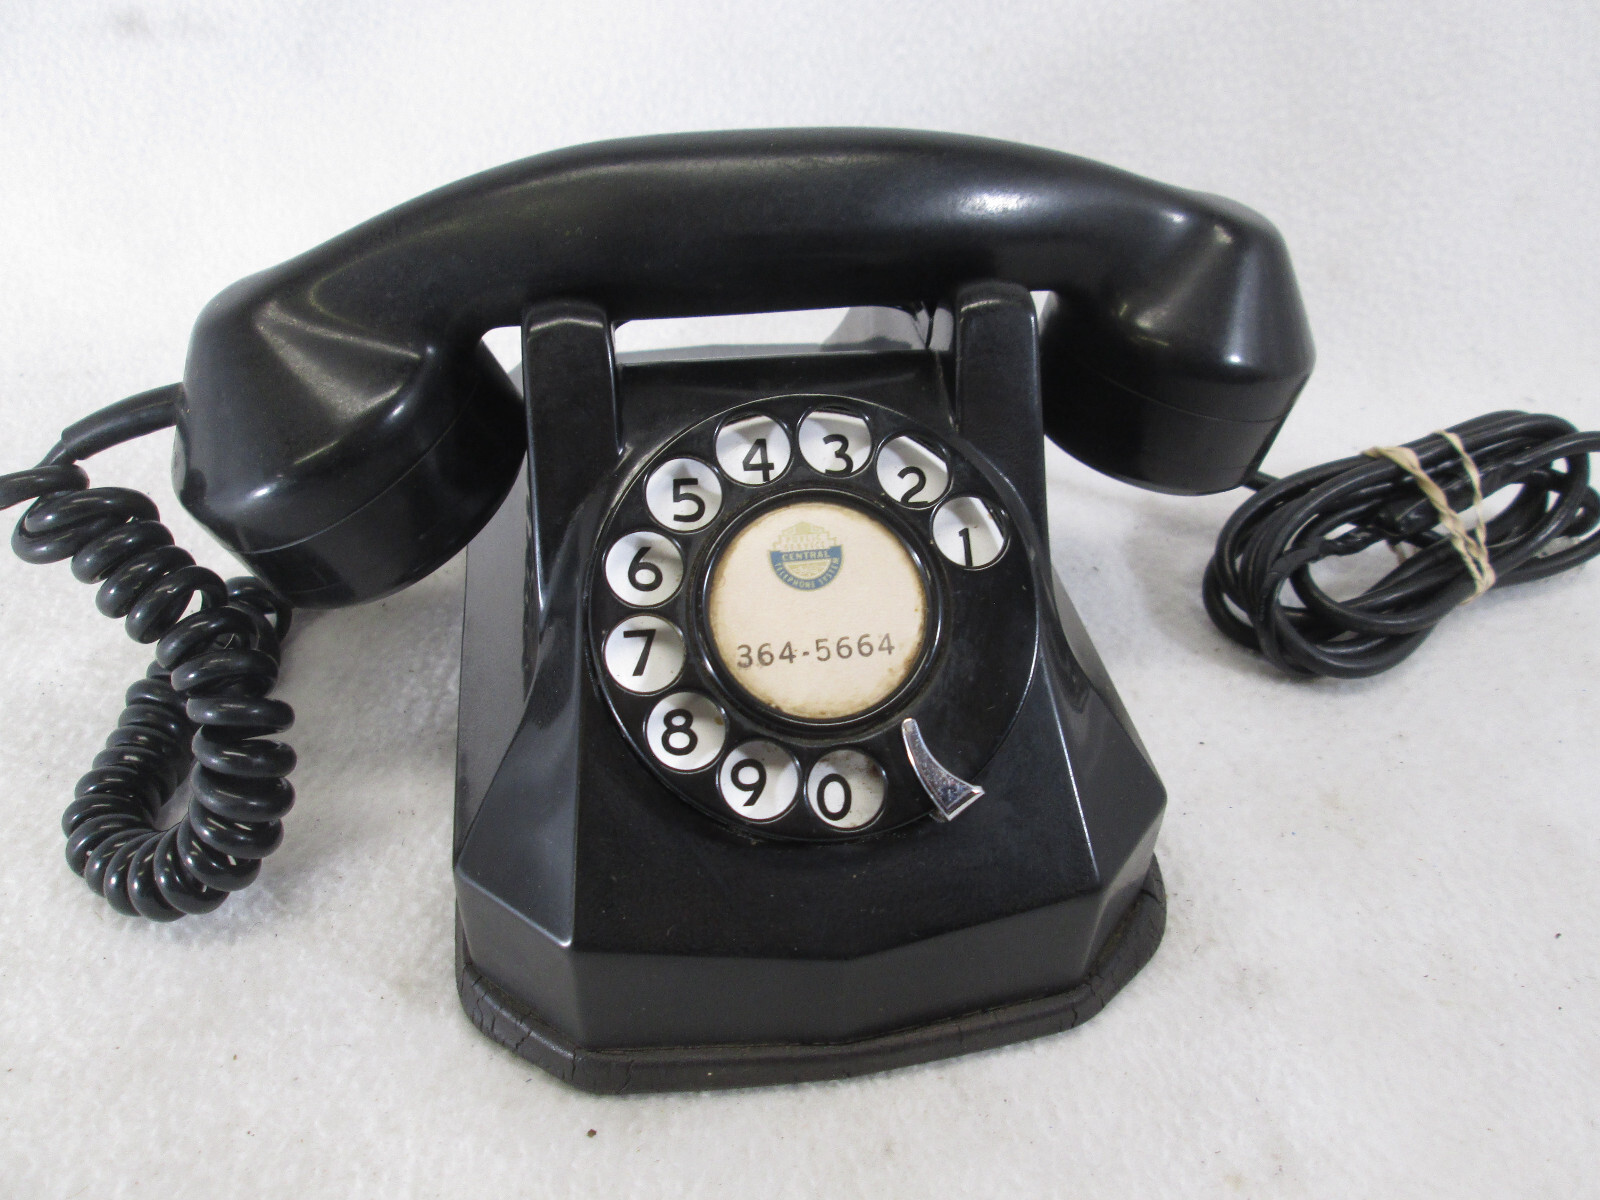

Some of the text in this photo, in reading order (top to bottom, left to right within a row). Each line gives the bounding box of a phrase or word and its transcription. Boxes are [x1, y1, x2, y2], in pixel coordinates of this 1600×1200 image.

[742, 438, 775, 483] 4
[823, 434, 853, 476] 3
[672, 478, 706, 522] 5
[898, 466, 929, 504] 2
[627, 546, 663, 591] 6
[781, 550, 828, 562] CENTRAL
[958, 527, 974, 567] 1
[623, 629, 657, 677] 7
[736, 633, 895, 669] 364-5664
[661, 709, 698, 756] 8
[730, 759, 768, 807] 9
[817, 773, 851, 821] 0
